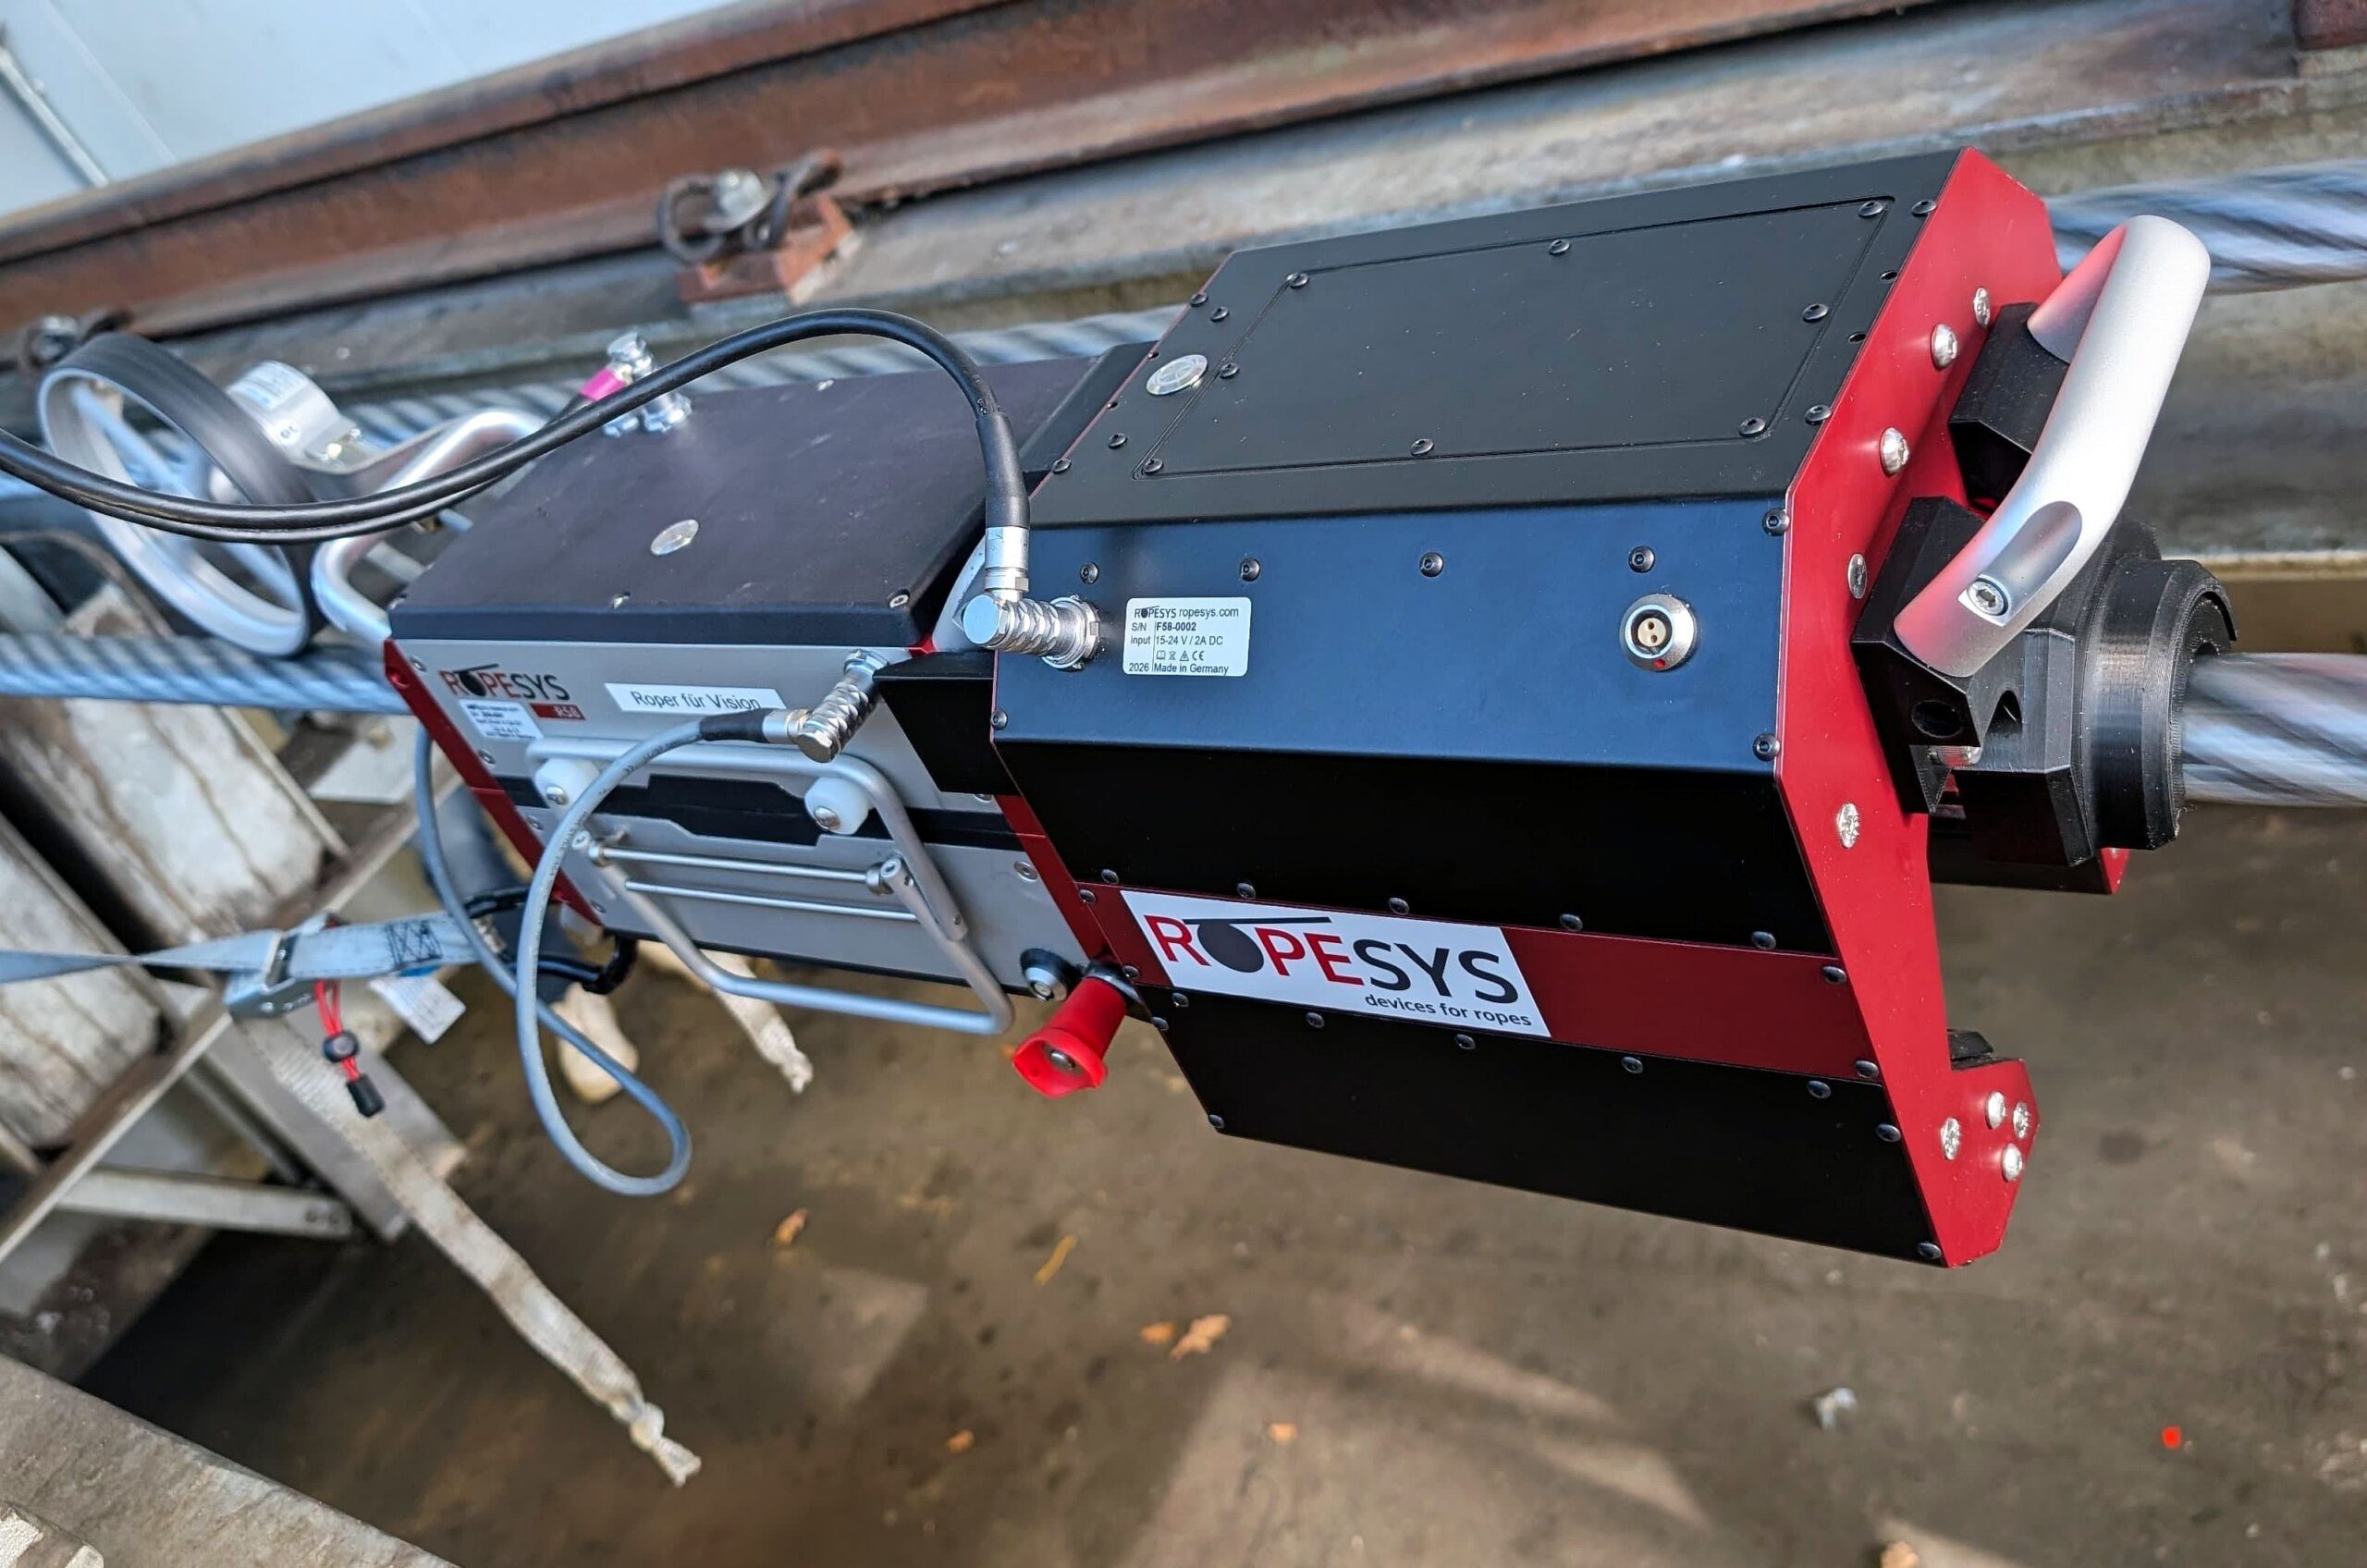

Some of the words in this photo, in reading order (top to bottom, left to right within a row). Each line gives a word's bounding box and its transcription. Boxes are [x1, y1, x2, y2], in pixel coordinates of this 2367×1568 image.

[1179, 607, 1239, 620] ropesys.com
[1131, 621, 1147, 631] S/N
[1156, 621, 1196, 631] F58-0002
[1130, 635, 1151, 646] Input
[1156, 635, 1179, 645] 15-24
[1181, 636, 1188, 645] V
[1195, 636, 1207, 645] 2A
[1208, 636, 1223, 645] DC
[1128, 662, 1149, 672] 2026
[1154, 664, 1177, 673] Made
[1179, 664, 1187, 673] in
[1189, 664, 1230, 676] Germany
[438, 664, 570, 701] ROPESYS
[631, 691, 679, 708] Roper
[681, 693, 705, 708] für
[707, 694, 762, 711] Vision
[1144, 914, 1519, 1005] ROPESYS
[1365, 994, 1436, 1014] devices
[1440, 1003, 1468, 1019] for
[1475, 1010, 1532, 1026] ropes
